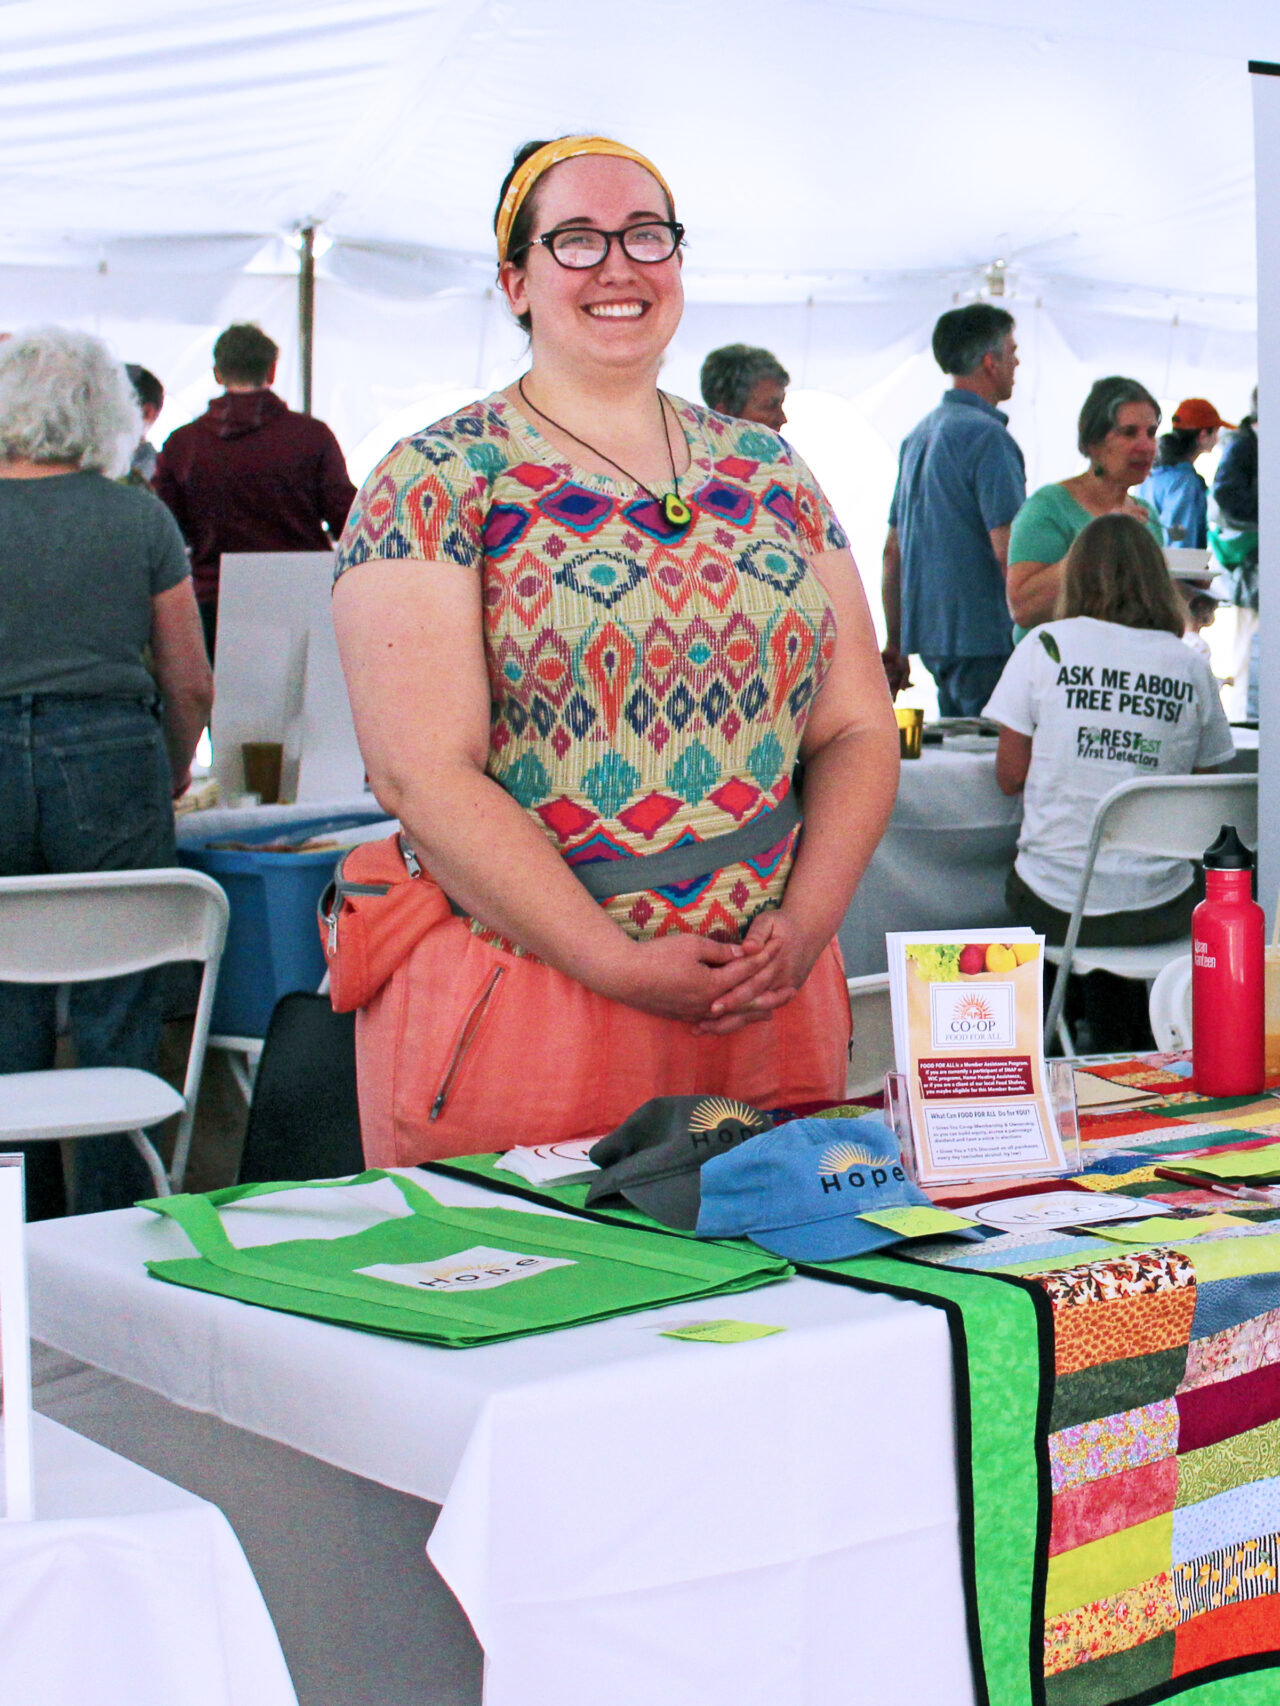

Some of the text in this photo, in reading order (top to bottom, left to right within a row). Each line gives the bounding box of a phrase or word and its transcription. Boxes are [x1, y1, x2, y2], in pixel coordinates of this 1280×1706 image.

[1056, 666, 1193, 703] ASK ME ABOUT
[1066, 688, 1183, 723] TREE PESTS!
[1107, 746, 1159, 767] Detectors
[691, 1128, 765, 1149] Hop
[821, 1164, 906, 1194] Hope
[418, 1259, 539, 1287] Hope
